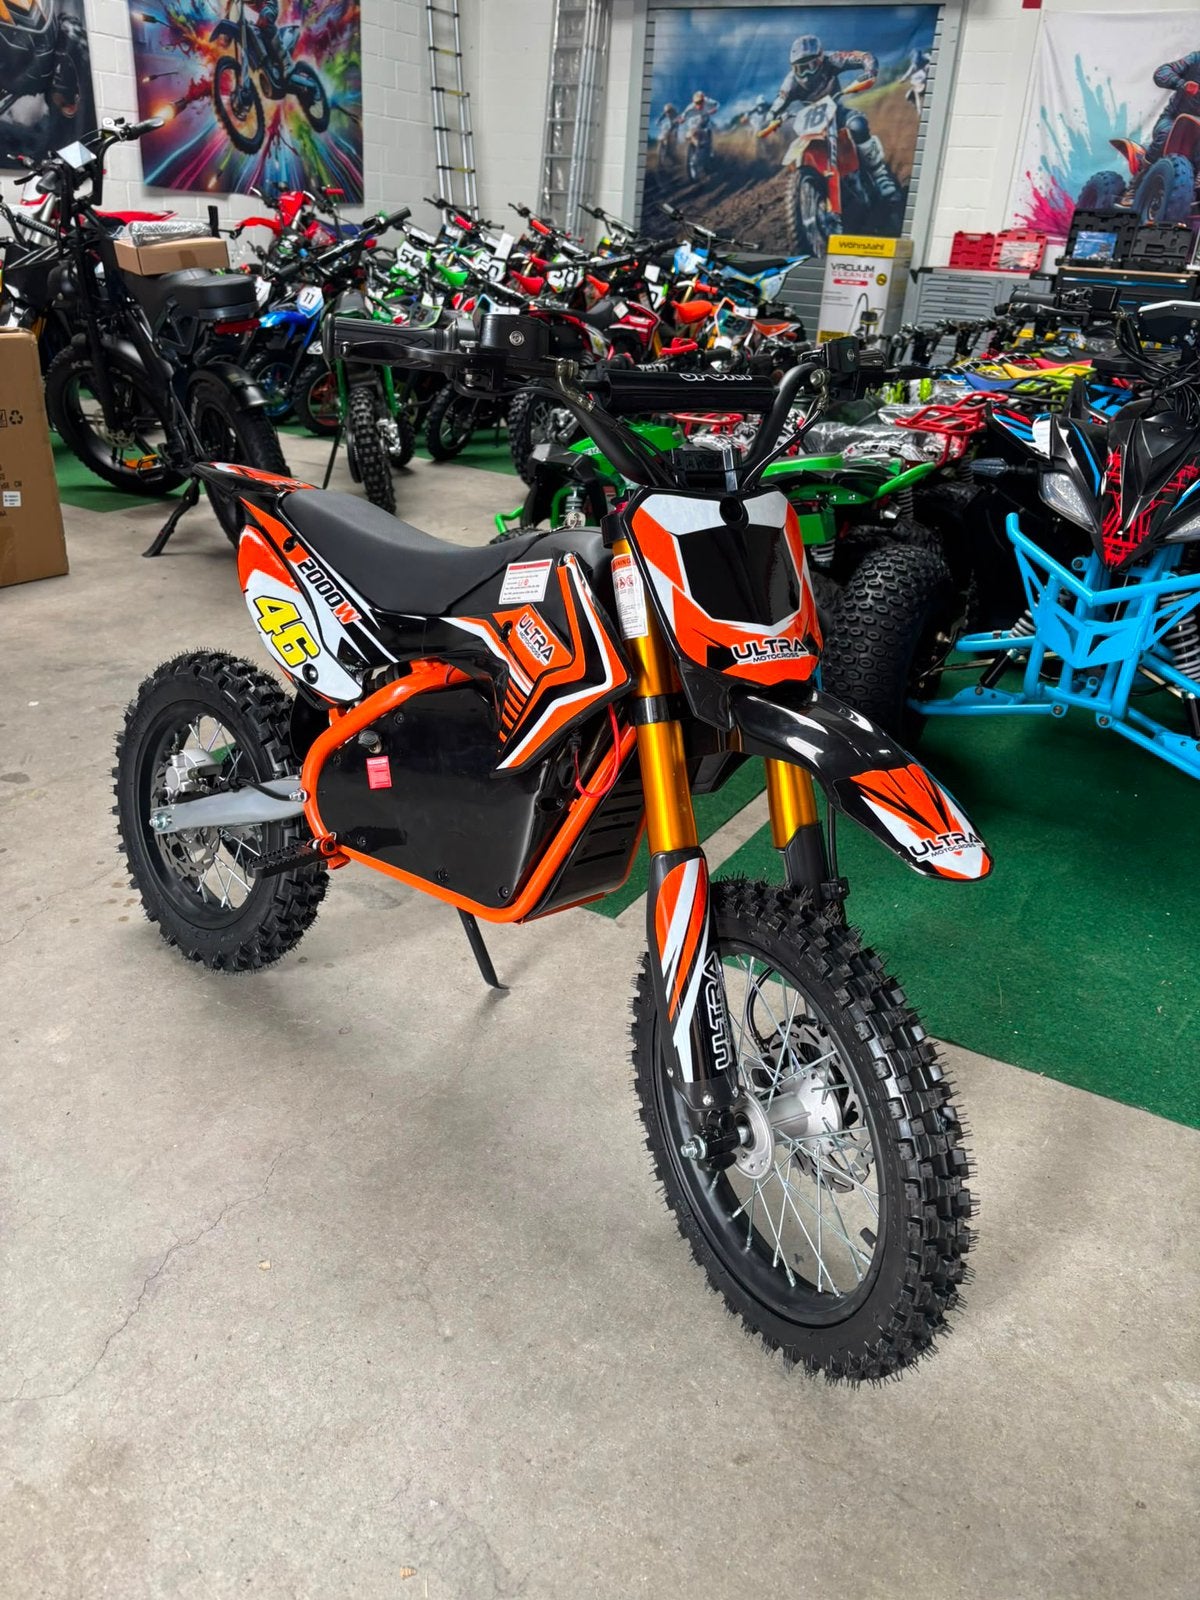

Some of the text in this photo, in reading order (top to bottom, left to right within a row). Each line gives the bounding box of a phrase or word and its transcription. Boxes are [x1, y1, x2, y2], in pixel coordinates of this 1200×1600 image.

[297, 557, 362, 625] 2000W
[253, 595, 320, 668] 46
[518, 613, 554, 662] ULTRA
[519, 631, 541, 659] MOTOCROSS
[732, 638, 808, 660] ULTRA
[752, 652, 800, 663] MOTOCROSS
[909, 832, 982, 857] ULTRA
[931, 842, 977, 858] MOTOCROSS
[702, 951, 731, 1071] ULTRA
